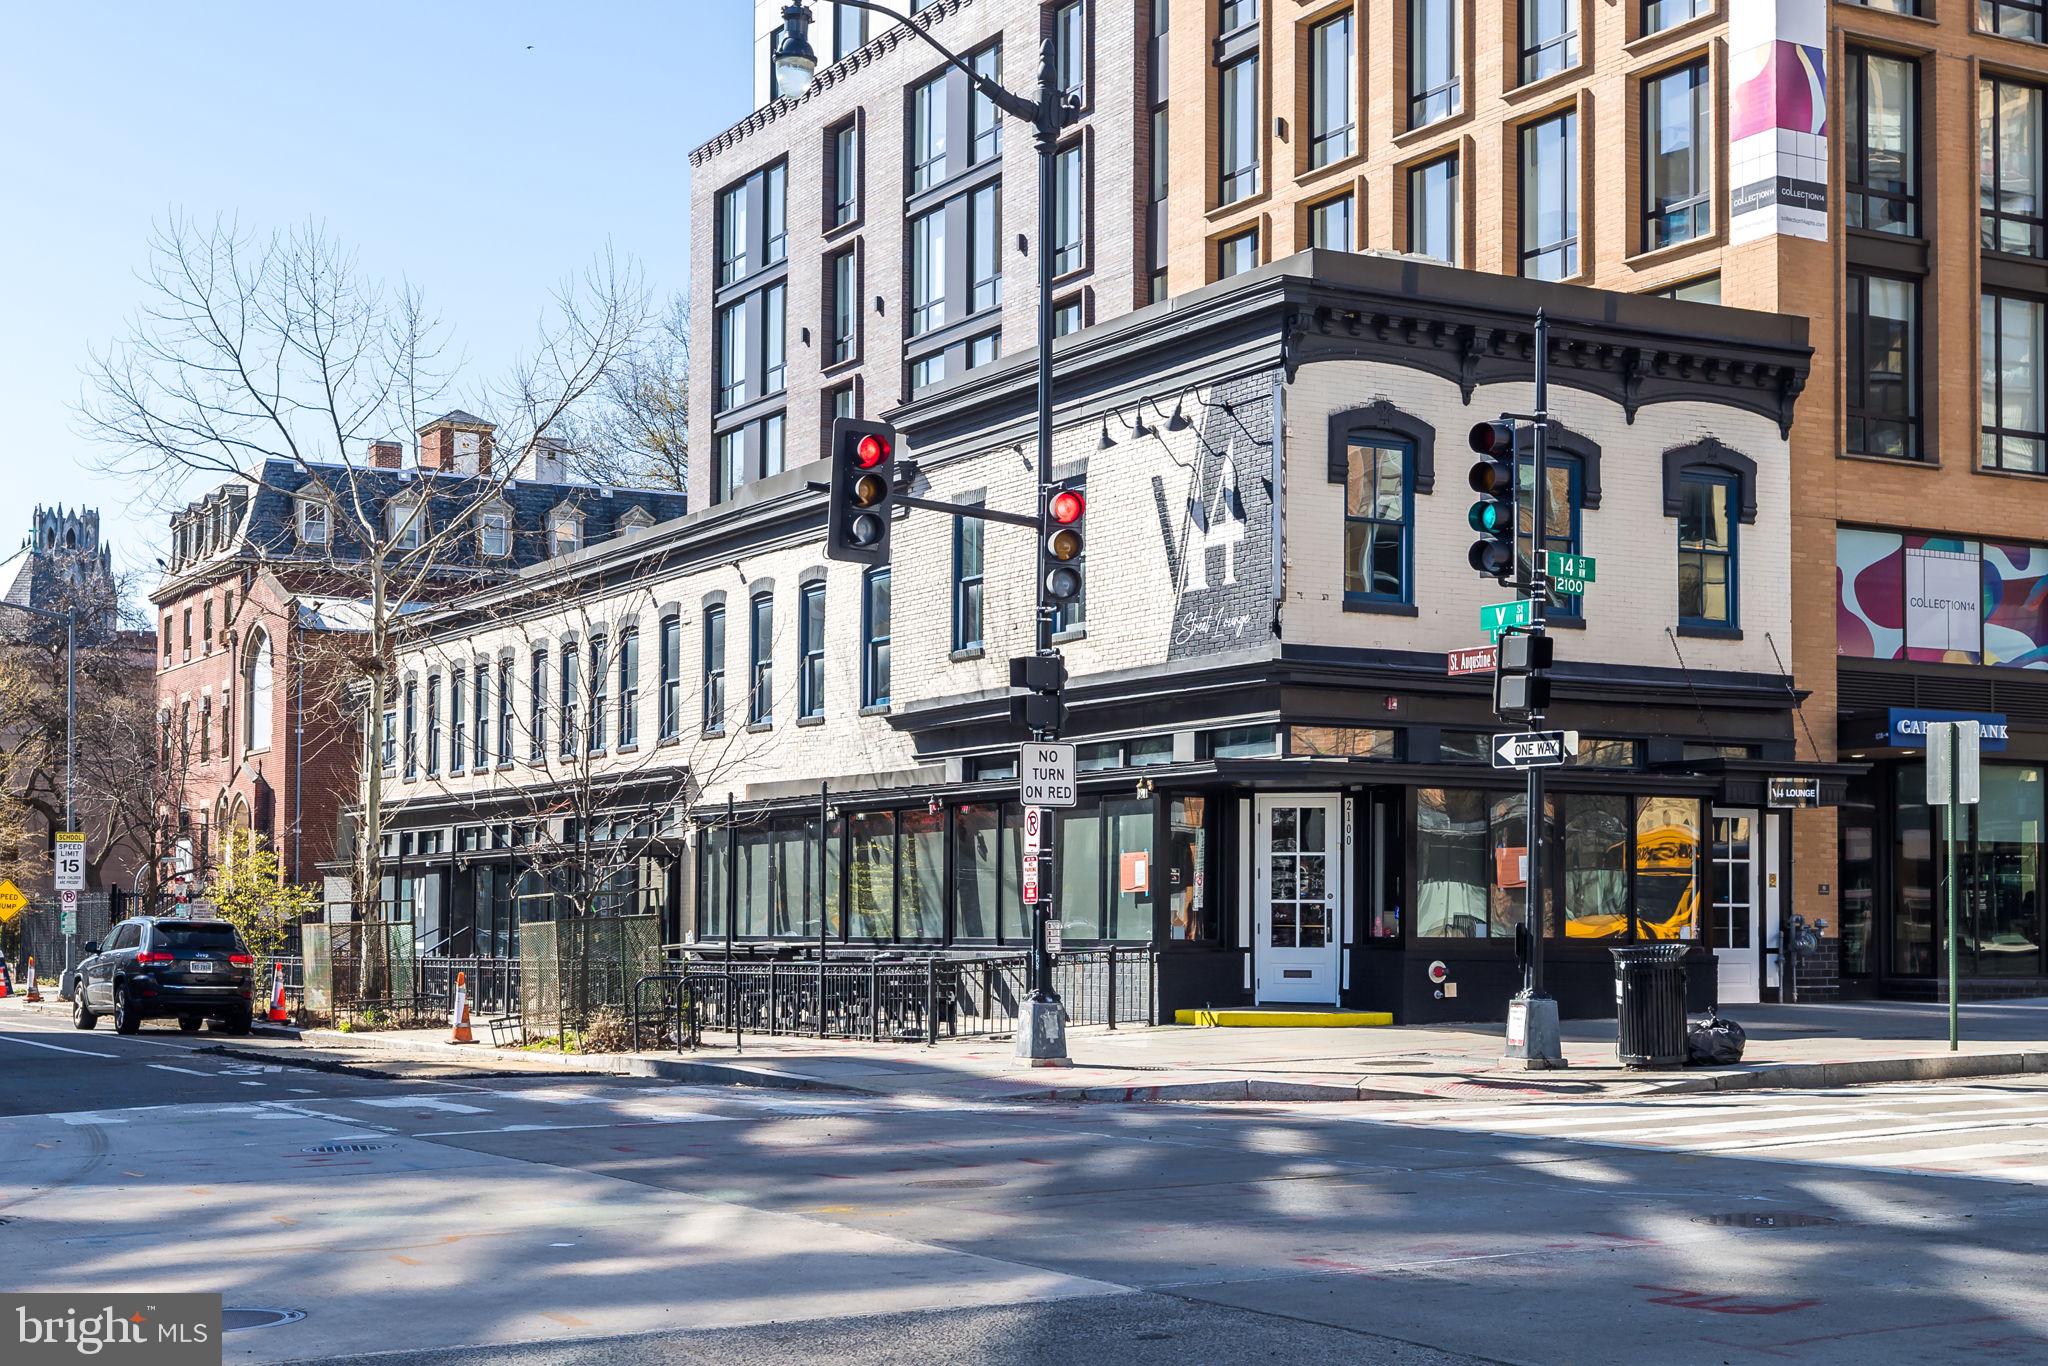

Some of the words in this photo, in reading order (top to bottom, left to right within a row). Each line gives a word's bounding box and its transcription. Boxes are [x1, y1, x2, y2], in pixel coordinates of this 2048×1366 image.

[1734, 186, 1775, 209] COLLECTION14
[1781, 182, 1825, 205] COLLECTION14
[1559, 556, 1574, 576] 14
[1557, 578, 1583, 592] 2100
[1910, 597, 1975, 612] COLLECTION14
[1495, 606, 1506, 626] V
[1175, 611, 1212, 645] Street
[1212, 606, 1251, 638] Lounge
[1450, 653, 1459, 671] St.
[1460, 650, 1490, 673] Augustine
[1979, 724, 2009, 738] ANK
[1514, 742, 1534, 756] ONE
[1536, 741, 1557, 755] WAY
[1038, 750, 1058, 763] NO
[1032, 768, 1064, 780] TURN
[1026, 786, 1042, 798] ON
[1048, 786, 1072, 798] RED
[1786, 788, 1816, 798] LOUNGE
[60, 860, 80, 872] 15
